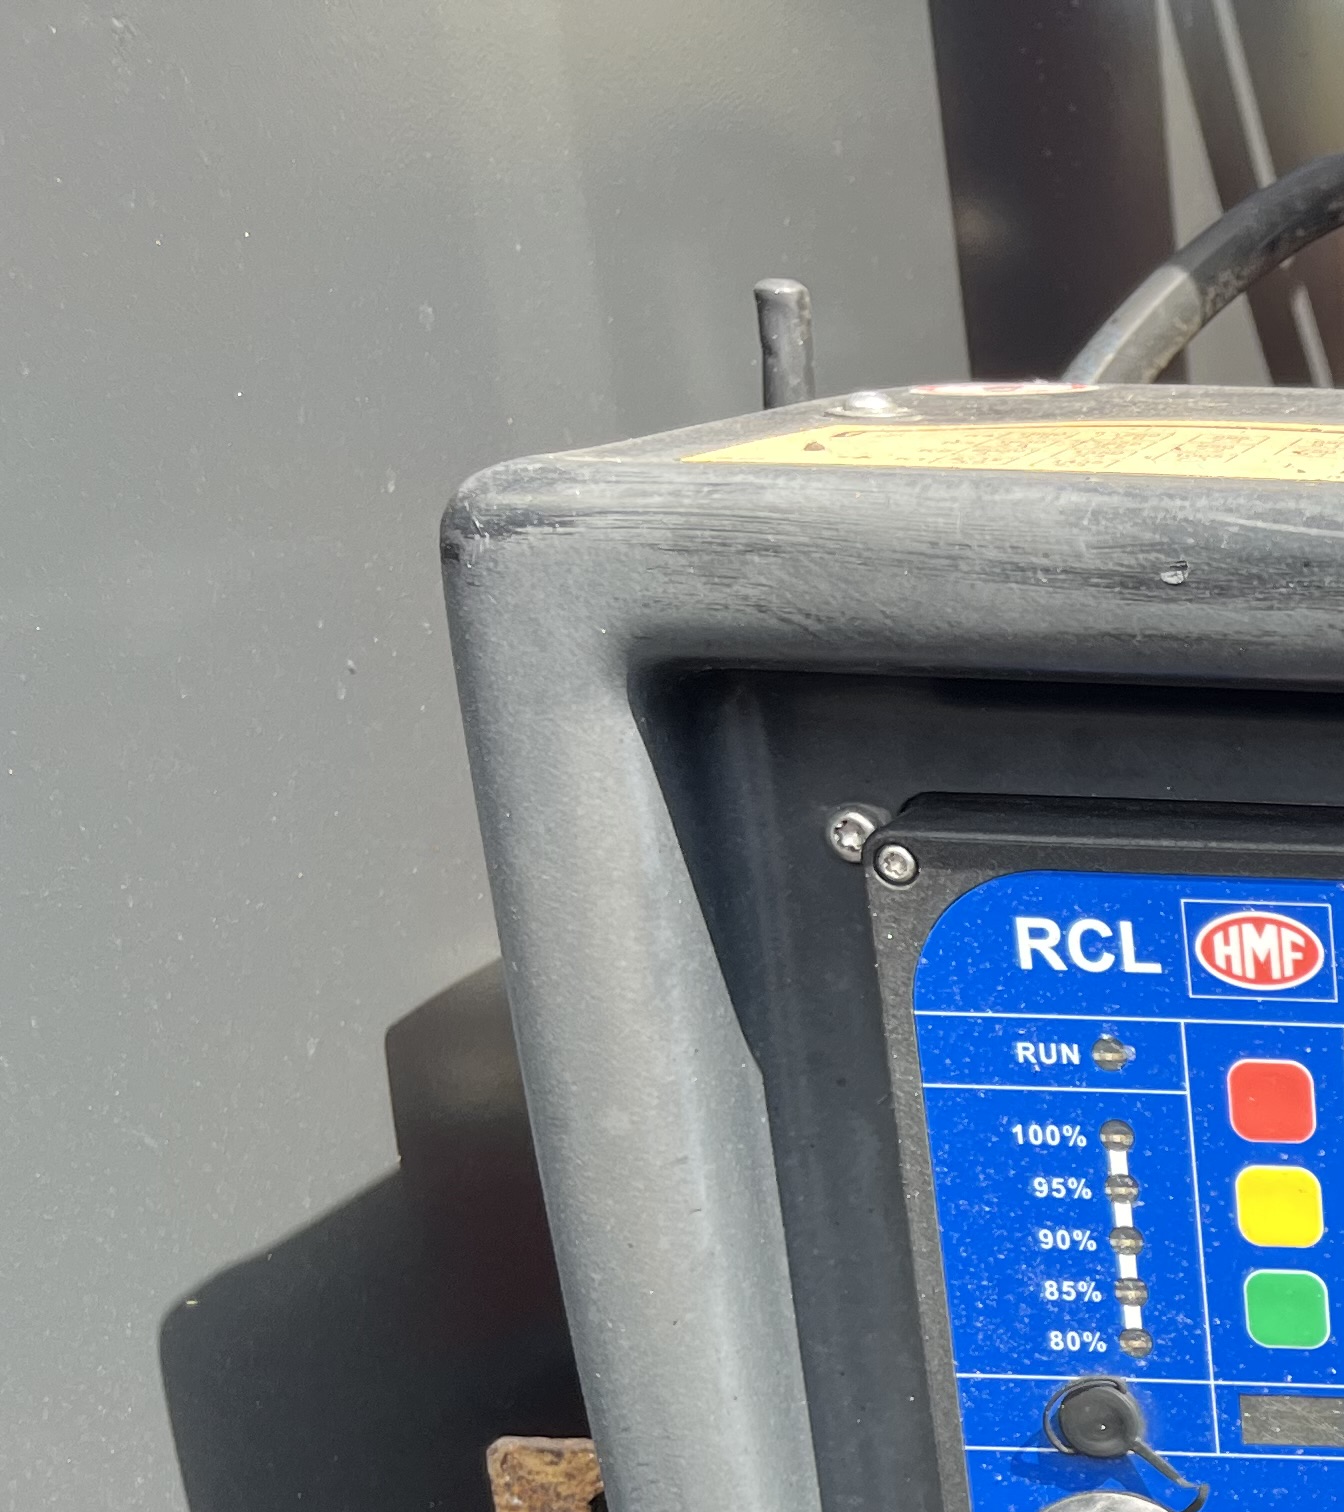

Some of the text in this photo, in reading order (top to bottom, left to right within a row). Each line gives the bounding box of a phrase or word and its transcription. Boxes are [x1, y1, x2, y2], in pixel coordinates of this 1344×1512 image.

[1015, 916, 1163, 974] RCL
[1212, 922, 1306, 980] HMF
[1015, 1041, 1080, 1065] RUN
[1012, 1123, 1087, 1147] 100%
[1033, 1176, 1092, 1200] 95%
[1038, 1228, 1097, 1251] 90%
[1043, 1280, 1103, 1303] 85%
[1048, 1330, 1107, 1353] 80%
